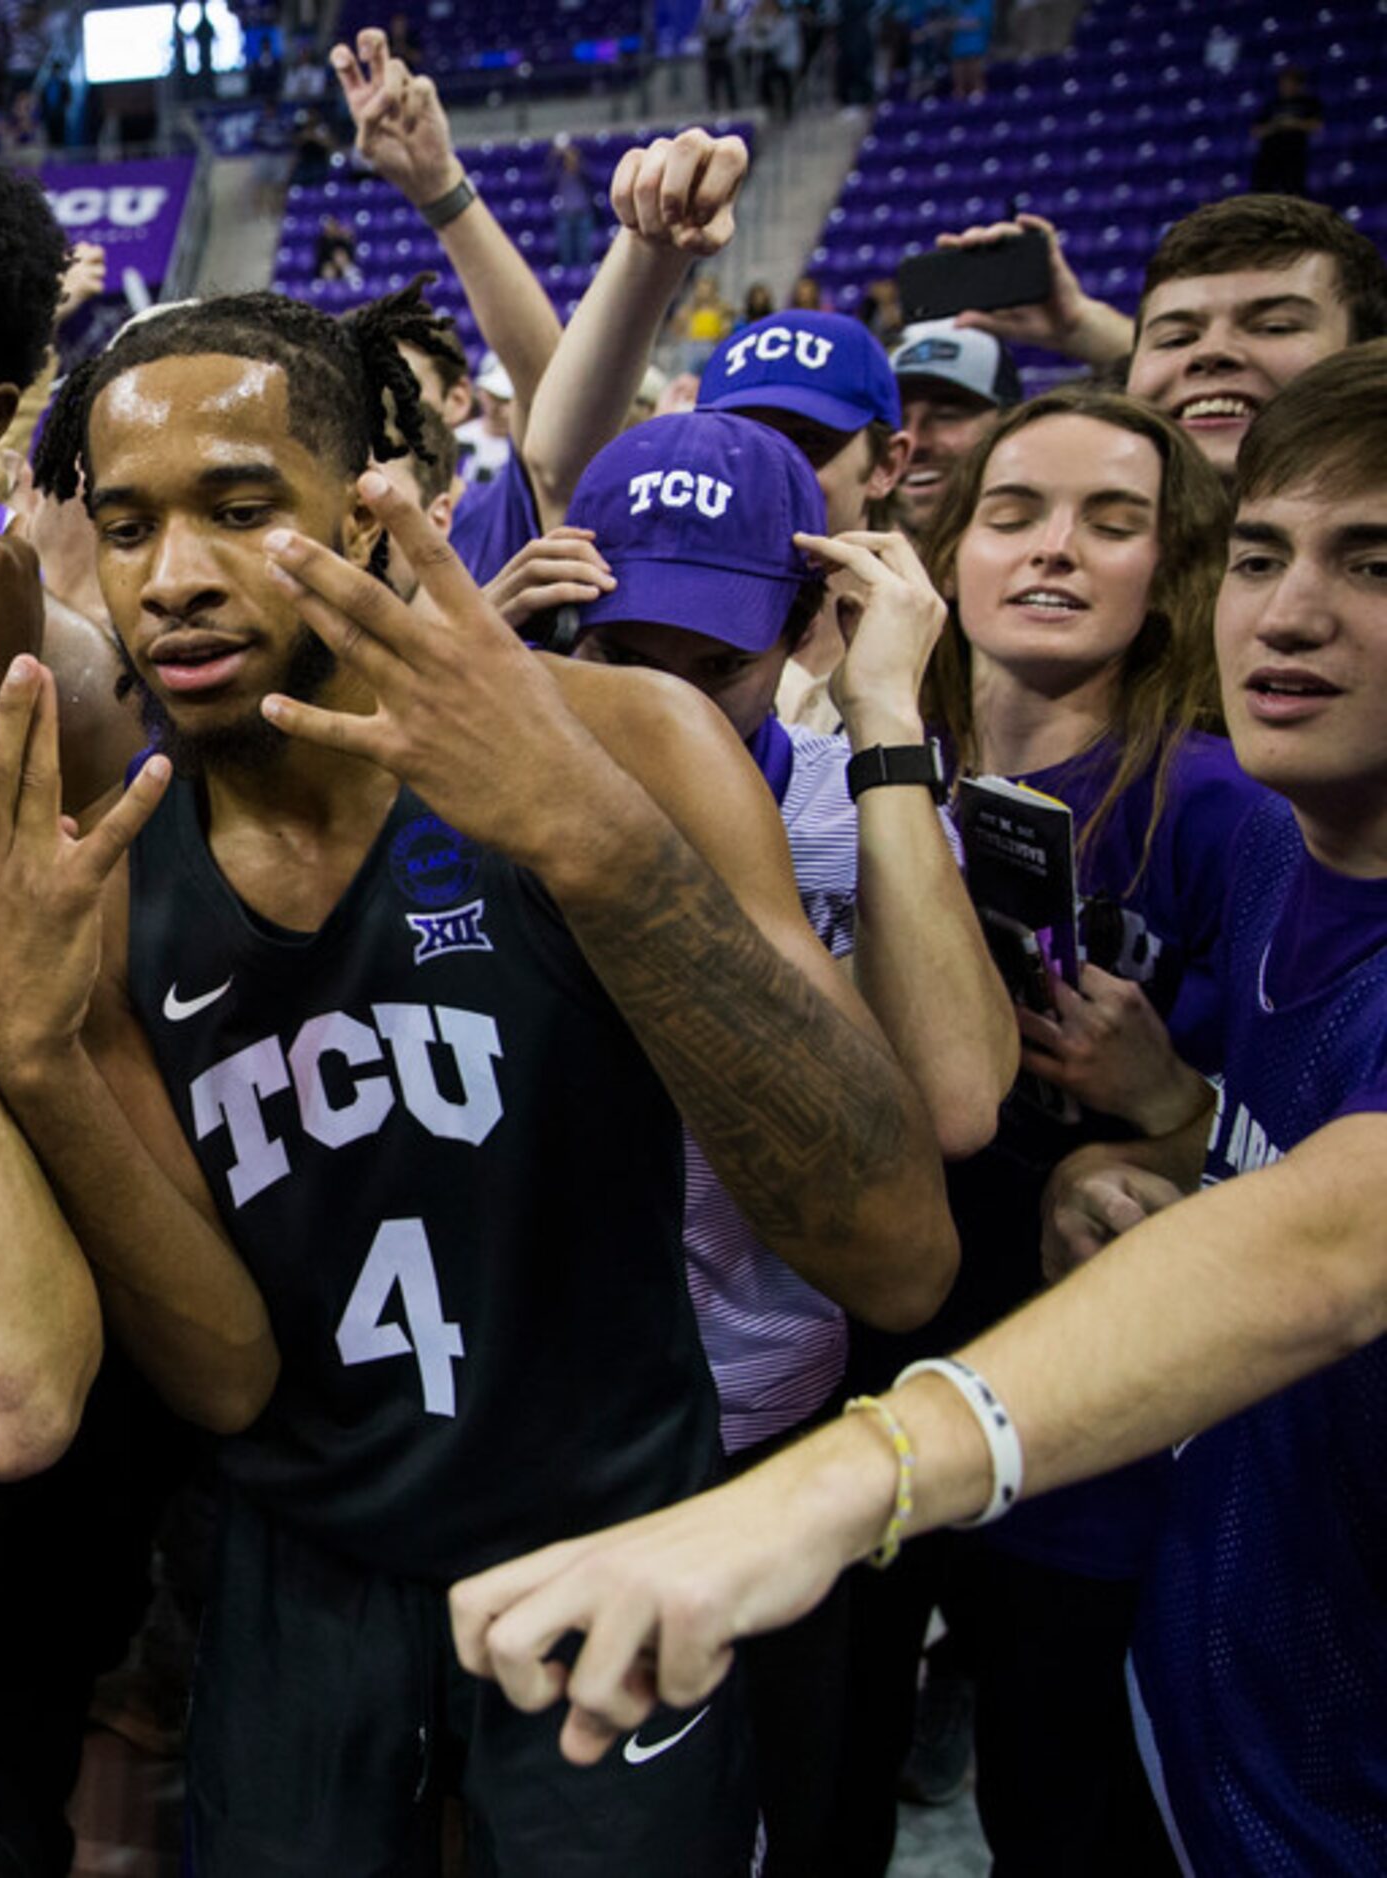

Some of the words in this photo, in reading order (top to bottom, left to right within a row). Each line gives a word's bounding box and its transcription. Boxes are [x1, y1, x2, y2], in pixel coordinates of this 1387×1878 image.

[43, 186, 168, 226] CU
[725, 326, 834, 375] TCU
[628, 468, 733, 518] TCU
[190, 1003, 504, 1209] TCU
[335, 1217, 465, 1418] 4
